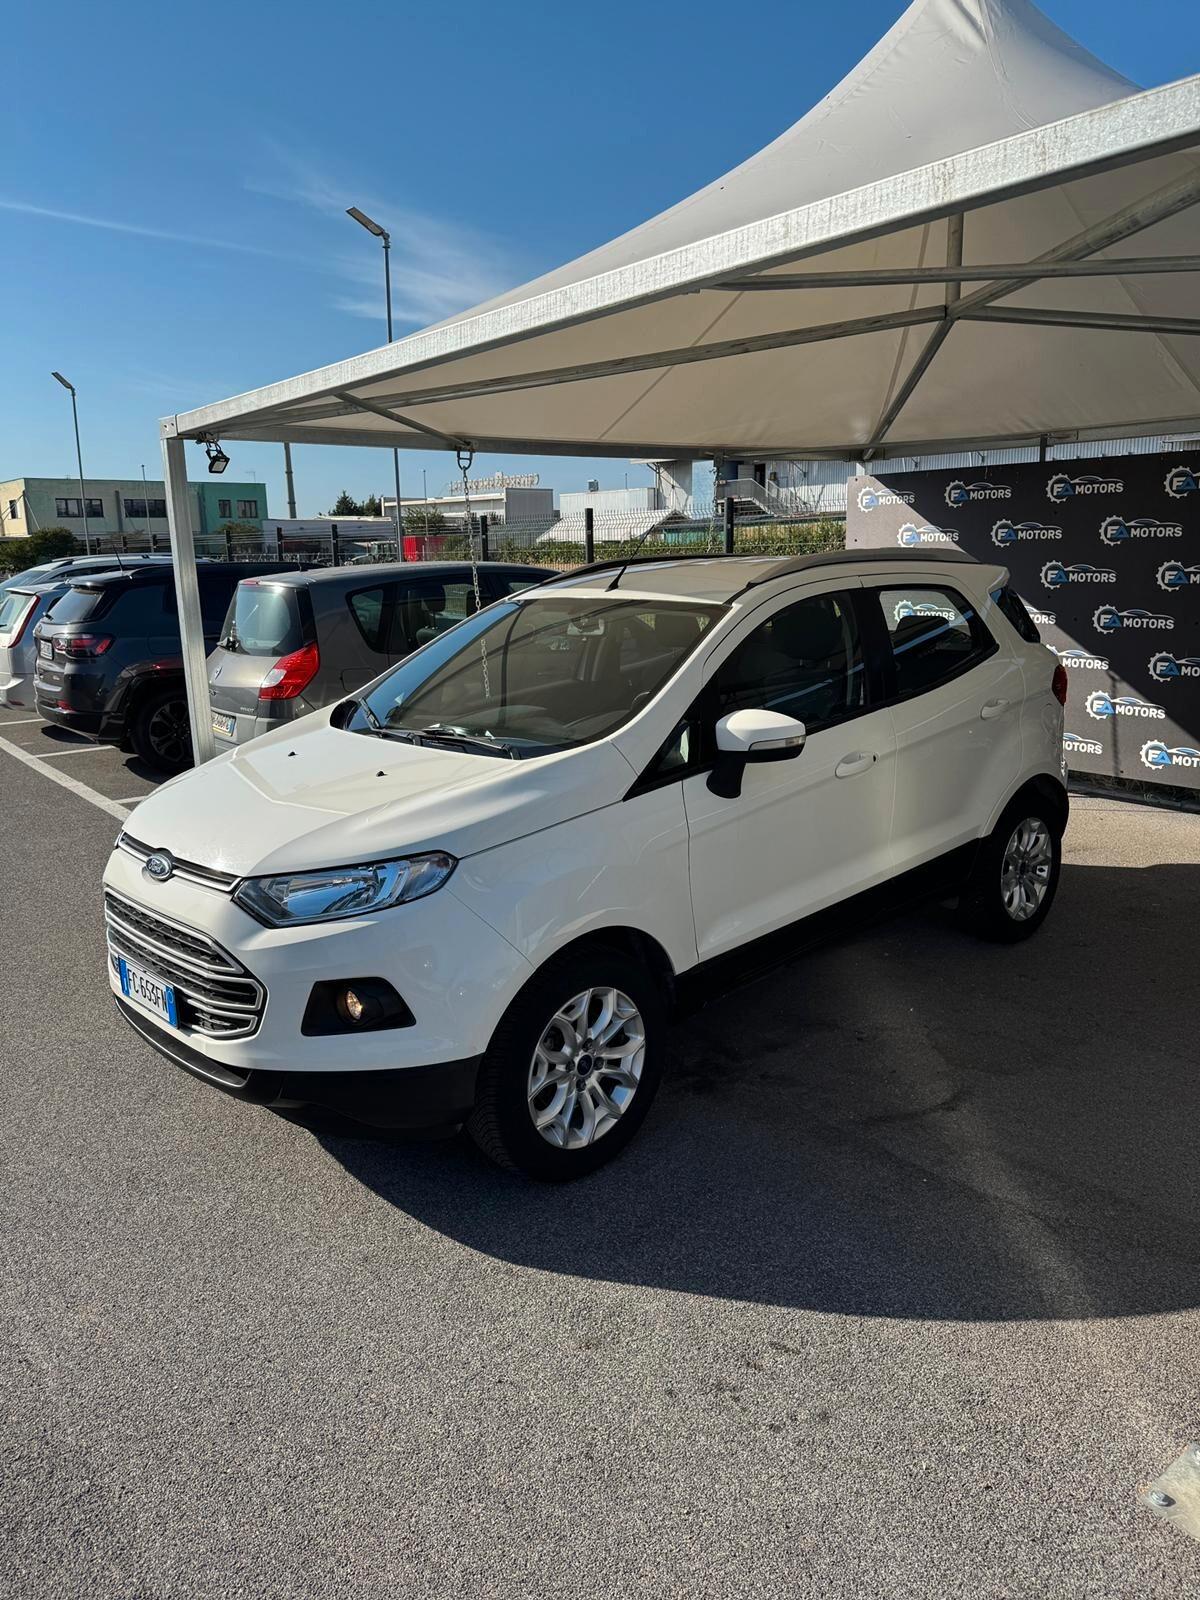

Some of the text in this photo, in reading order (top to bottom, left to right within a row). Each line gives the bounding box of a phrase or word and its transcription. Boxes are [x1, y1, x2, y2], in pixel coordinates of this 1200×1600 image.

[969, 487, 1012, 500] MOTORS
[1074, 482, 1124, 496] MOTORS
[879, 495, 915, 505] MOTORS
[920, 532, 959, 542] MOTORS
[1018, 528, 1063, 540] MOTORS
[1130, 525, 1183, 538] MOTORS
[1068, 571, 1117, 583] MOTORS
[1123, 617, 1175, 629] MOTORS
[1062, 657, 1109, 670] MOTORS
[1115, 705, 1166, 719] MOTORS
[1063, 740, 1102, 754] OTORS
[1172, 754, 1200, 768] MOT
